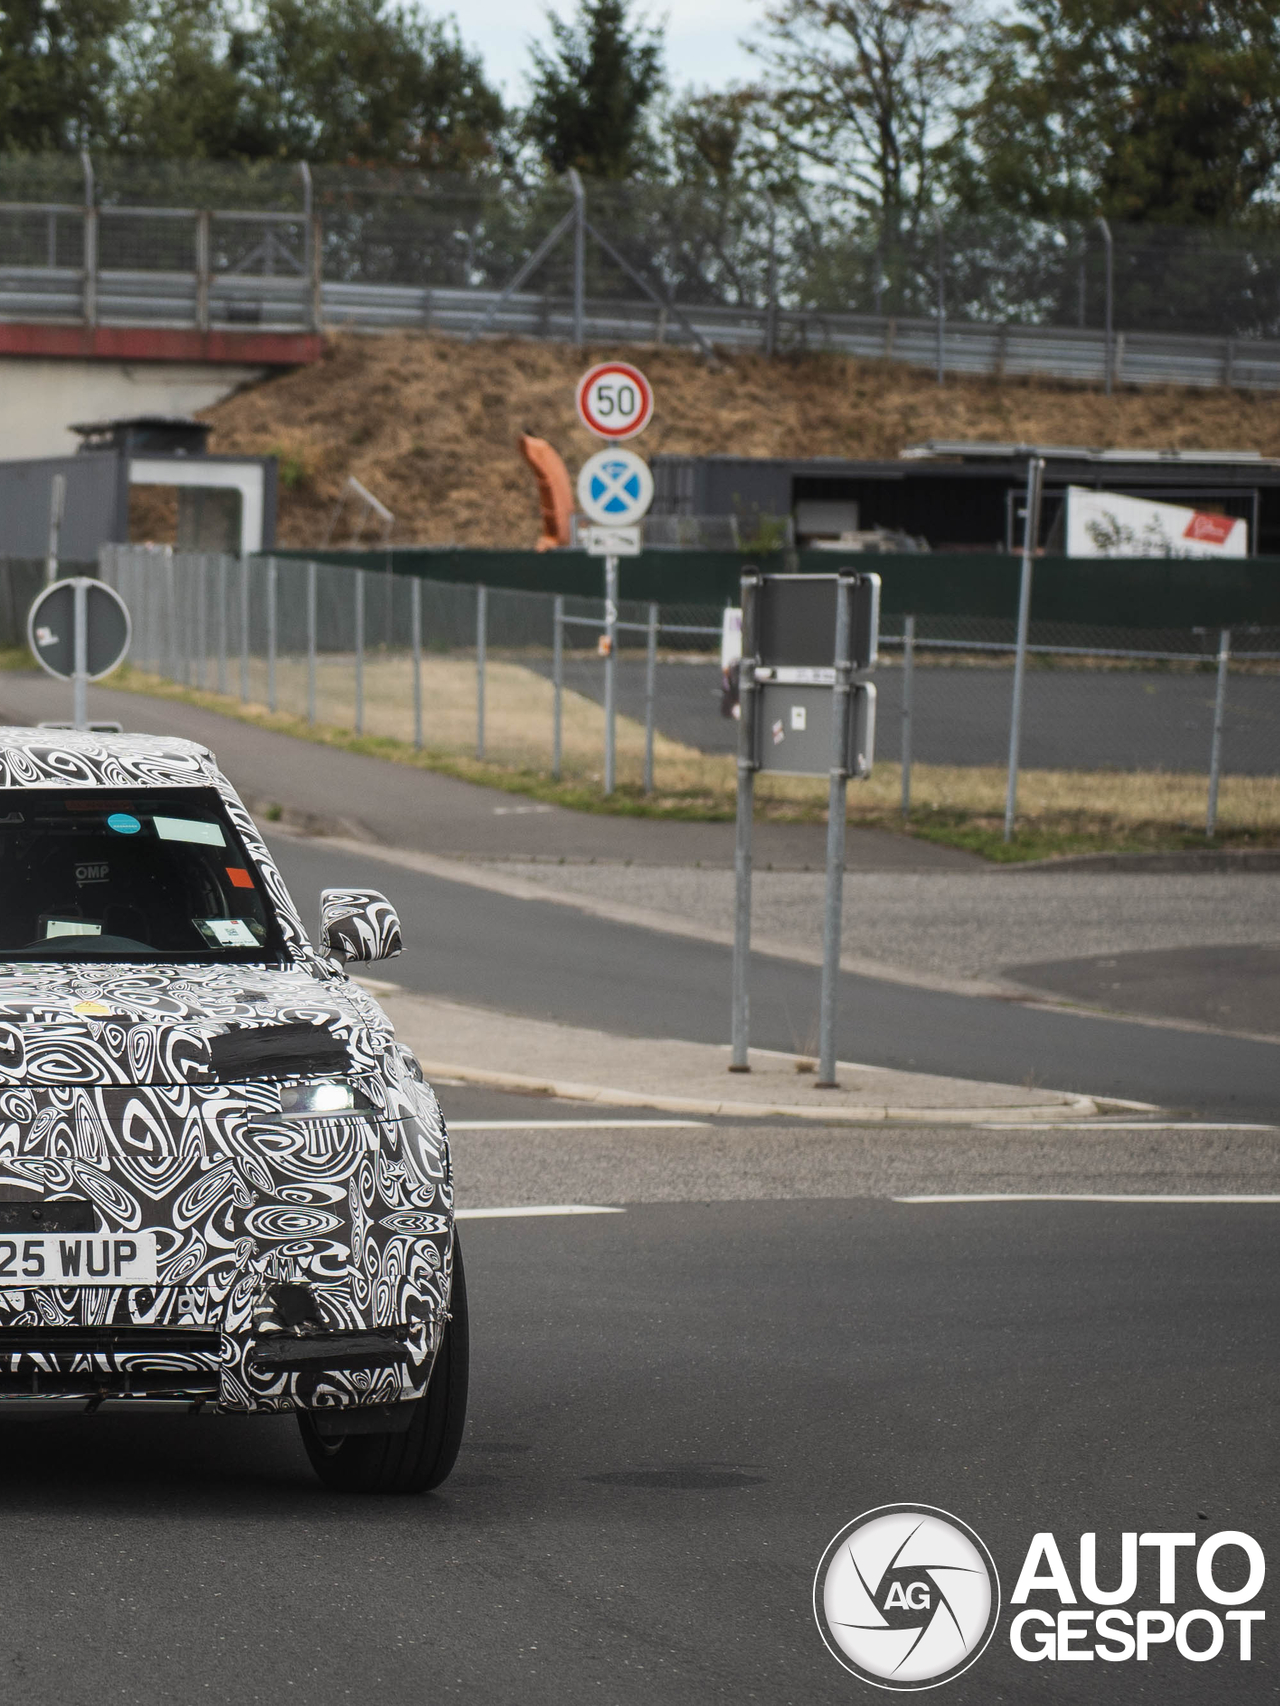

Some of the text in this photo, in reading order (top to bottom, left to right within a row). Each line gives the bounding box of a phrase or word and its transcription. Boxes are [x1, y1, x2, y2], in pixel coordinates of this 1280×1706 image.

[596, 385, 635, 417] 50
[75, 864, 110, 879] OMP
[58, 1239, 138, 1277] WUP
